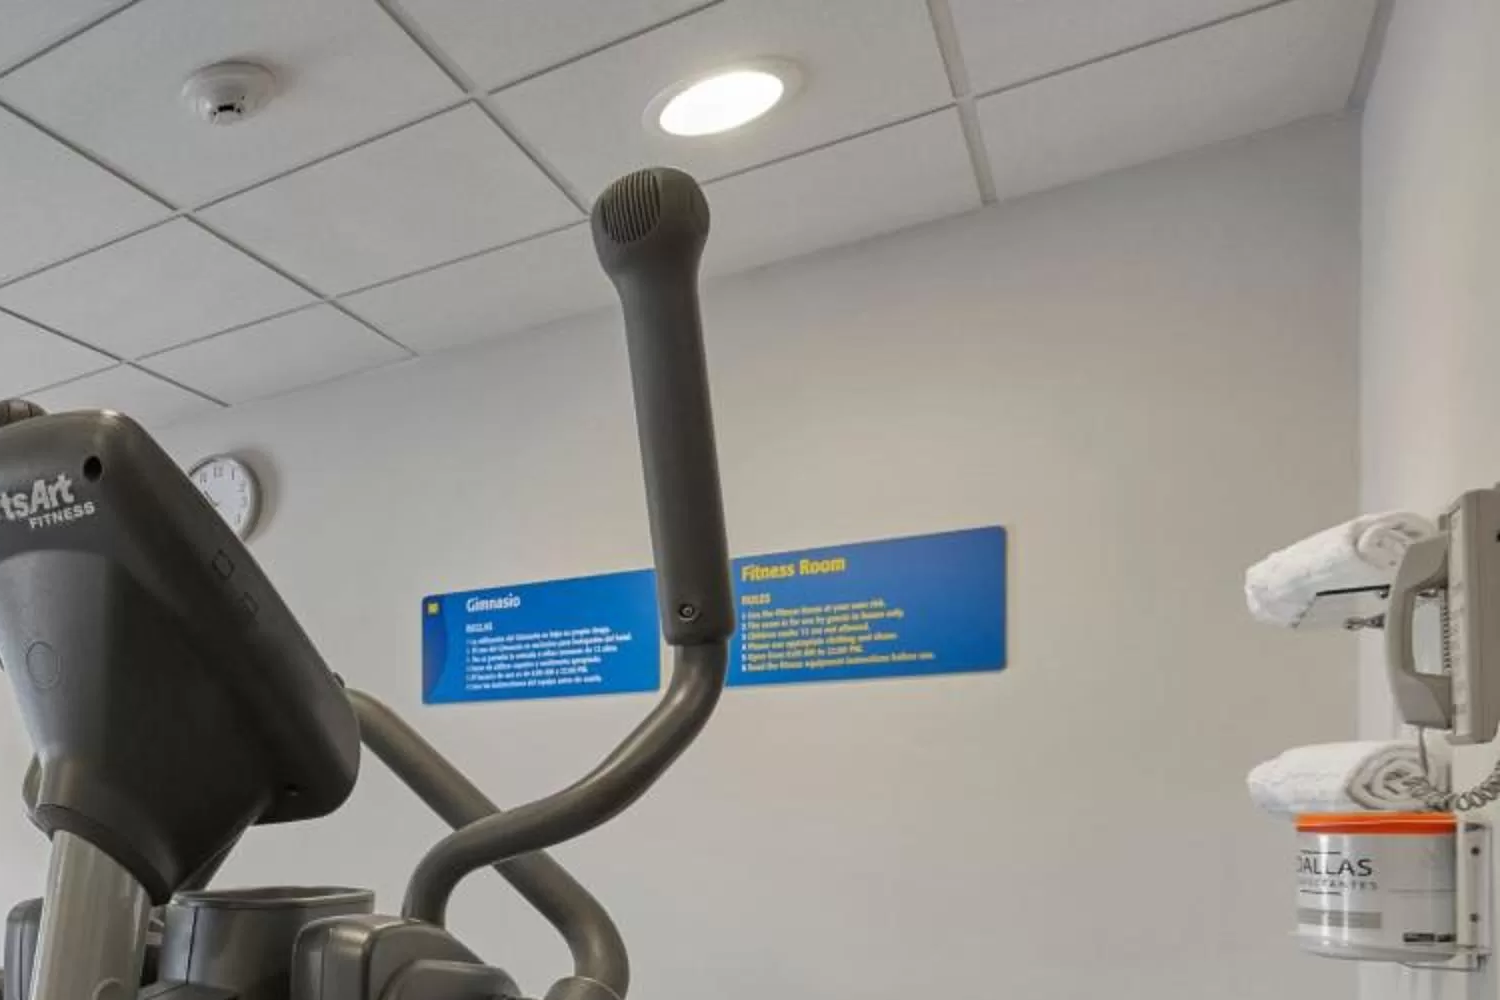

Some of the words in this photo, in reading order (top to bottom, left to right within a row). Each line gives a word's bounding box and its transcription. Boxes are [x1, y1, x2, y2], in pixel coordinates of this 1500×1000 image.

[28, 501, 96, 529] FITNESS
[741, 564, 795, 582] Fitness
[800, 557, 846, 576] Room
[466, 592, 521, 613] Gimnasio
